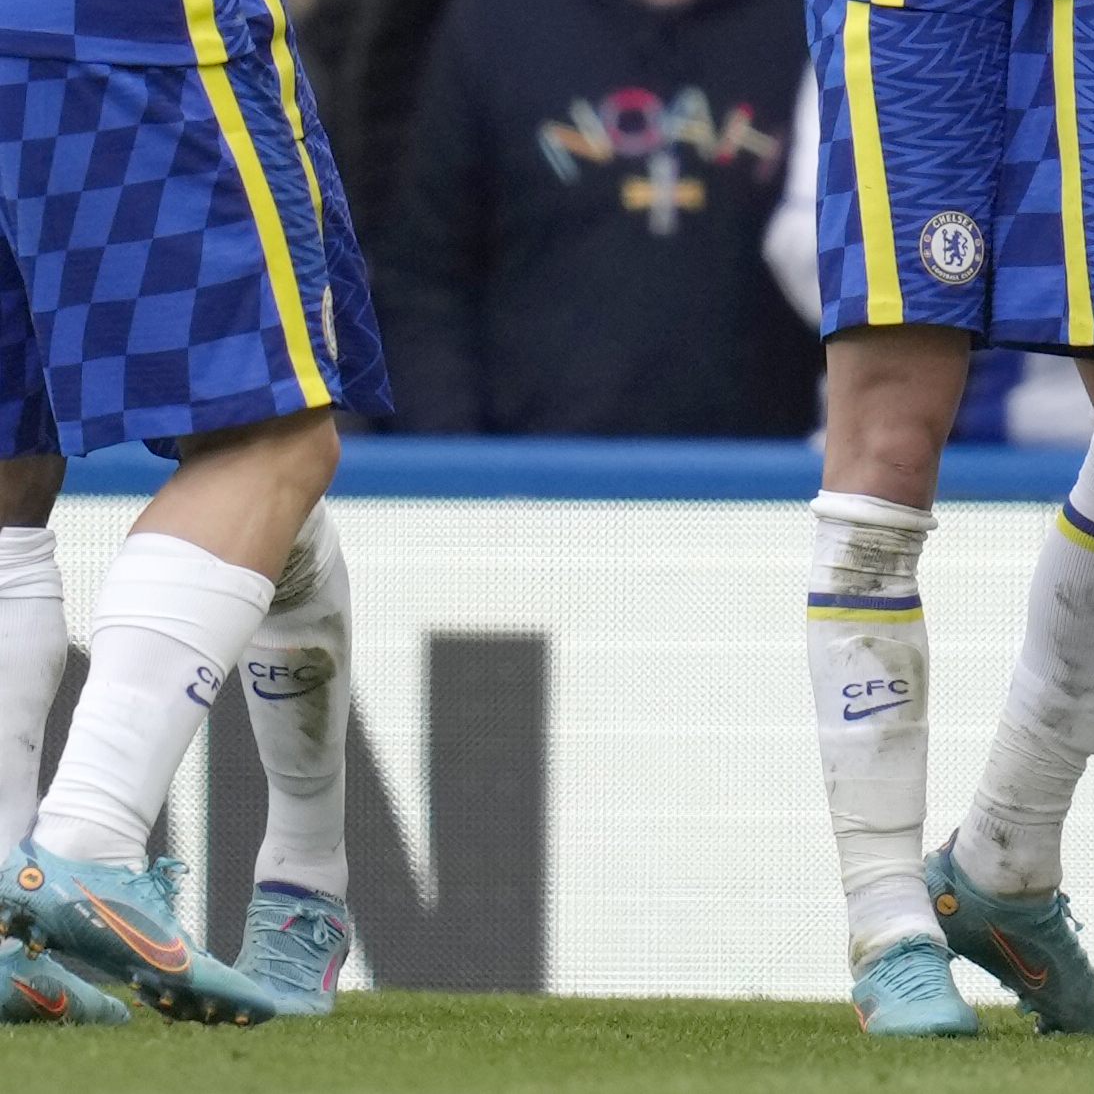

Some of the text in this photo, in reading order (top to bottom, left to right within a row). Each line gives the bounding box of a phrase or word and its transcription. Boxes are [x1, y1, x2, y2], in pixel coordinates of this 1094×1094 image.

[932, 214, 974, 232] CHELSEA
[197, 666, 221, 691] CF
[248, 661, 318, 682] CFC
[842, 679, 910, 698] CFC
